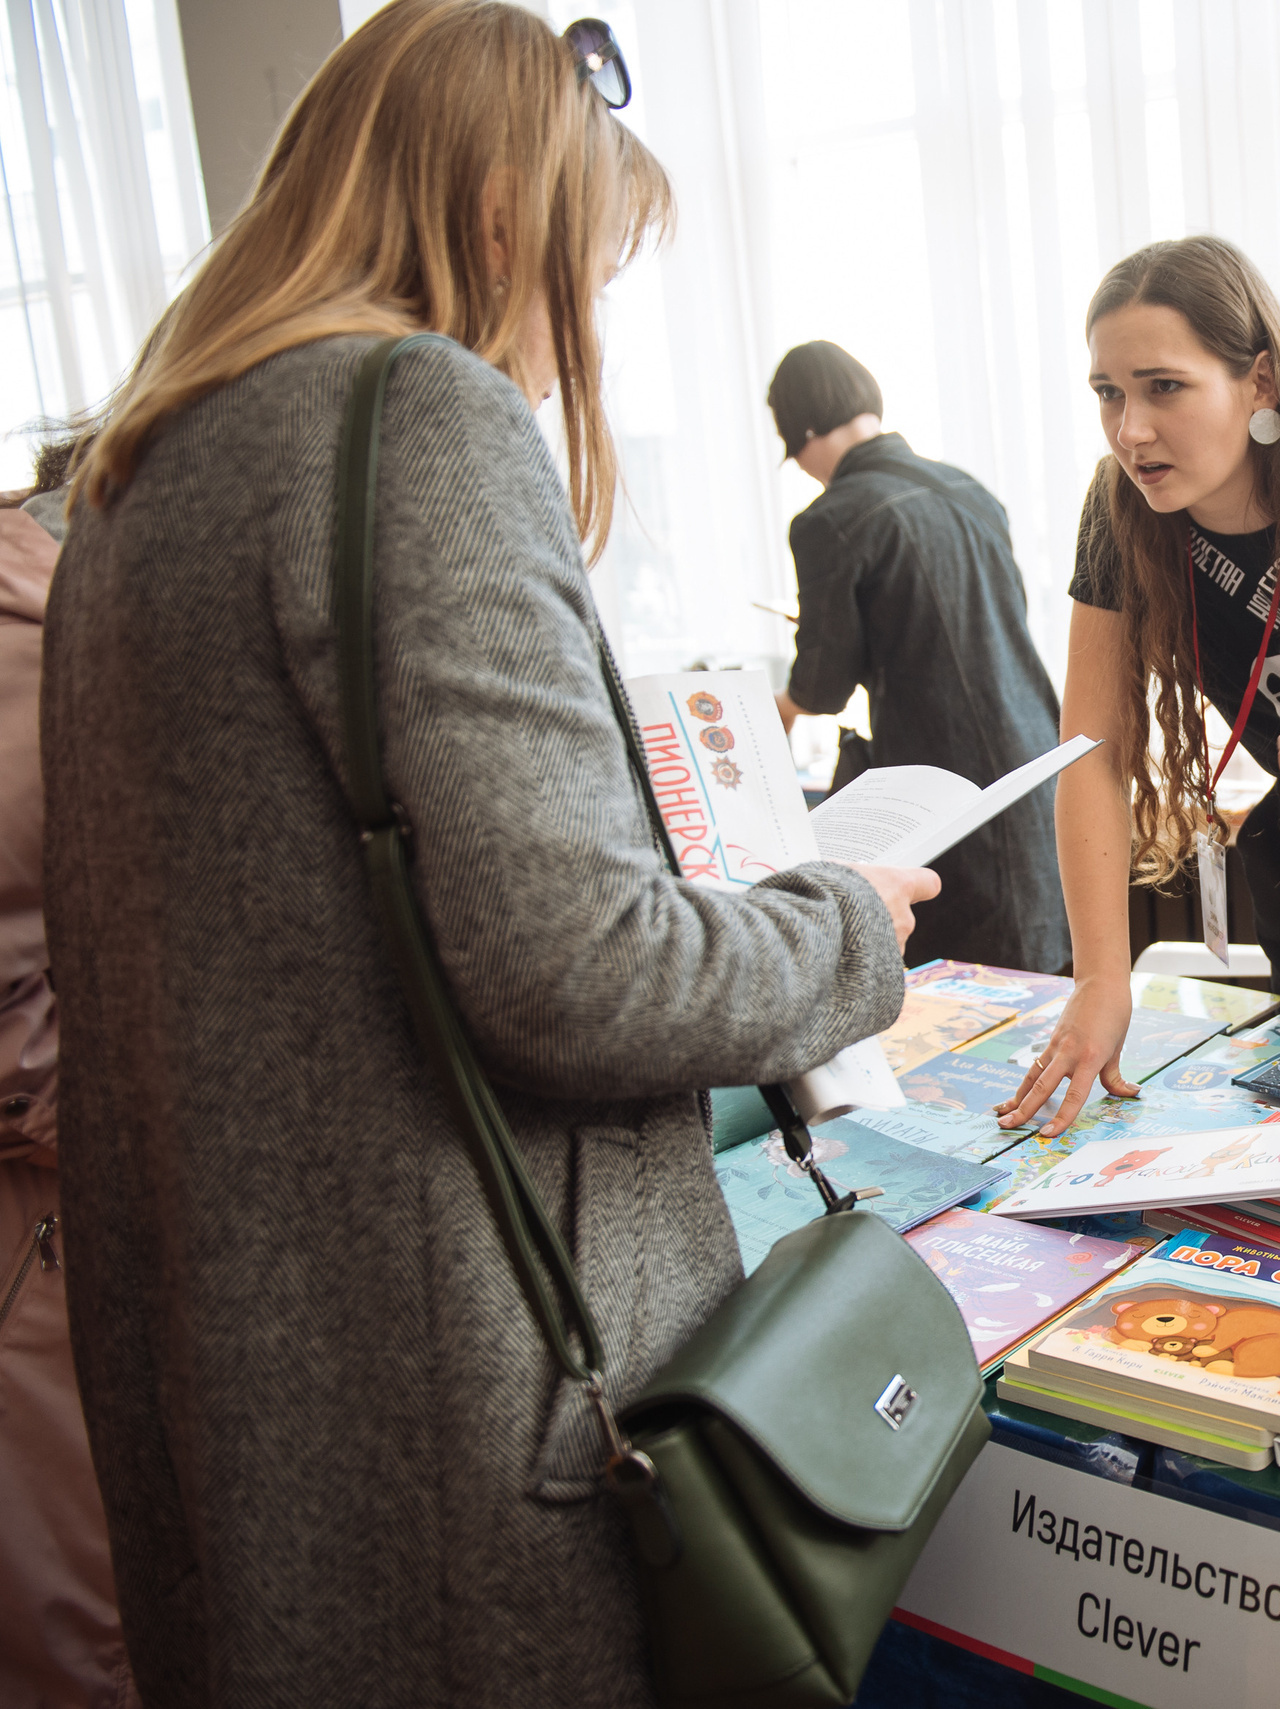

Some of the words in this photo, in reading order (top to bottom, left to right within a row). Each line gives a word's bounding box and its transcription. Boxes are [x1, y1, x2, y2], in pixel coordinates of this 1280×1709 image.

[642, 722, 721, 881] ПИОНЕРСК
[1177, 1071, 1215, 1086] 50
[857, 1117, 939, 1145] ПИРАТЫ
[1233, 1215, 1261, 1228] CLEVER
[921, 1236, 1047, 1272] ПЛИСЕЦКАЯ
[970, 1233, 1030, 1254] МАЙЯ
[1169, 1246, 1261, 1277] ПОРА
[1083, 1347, 1115, 1363] Гарри
[1153, 1367, 1185, 1380] CLEVER
[1076, 1592, 1201, 1673] Clever
